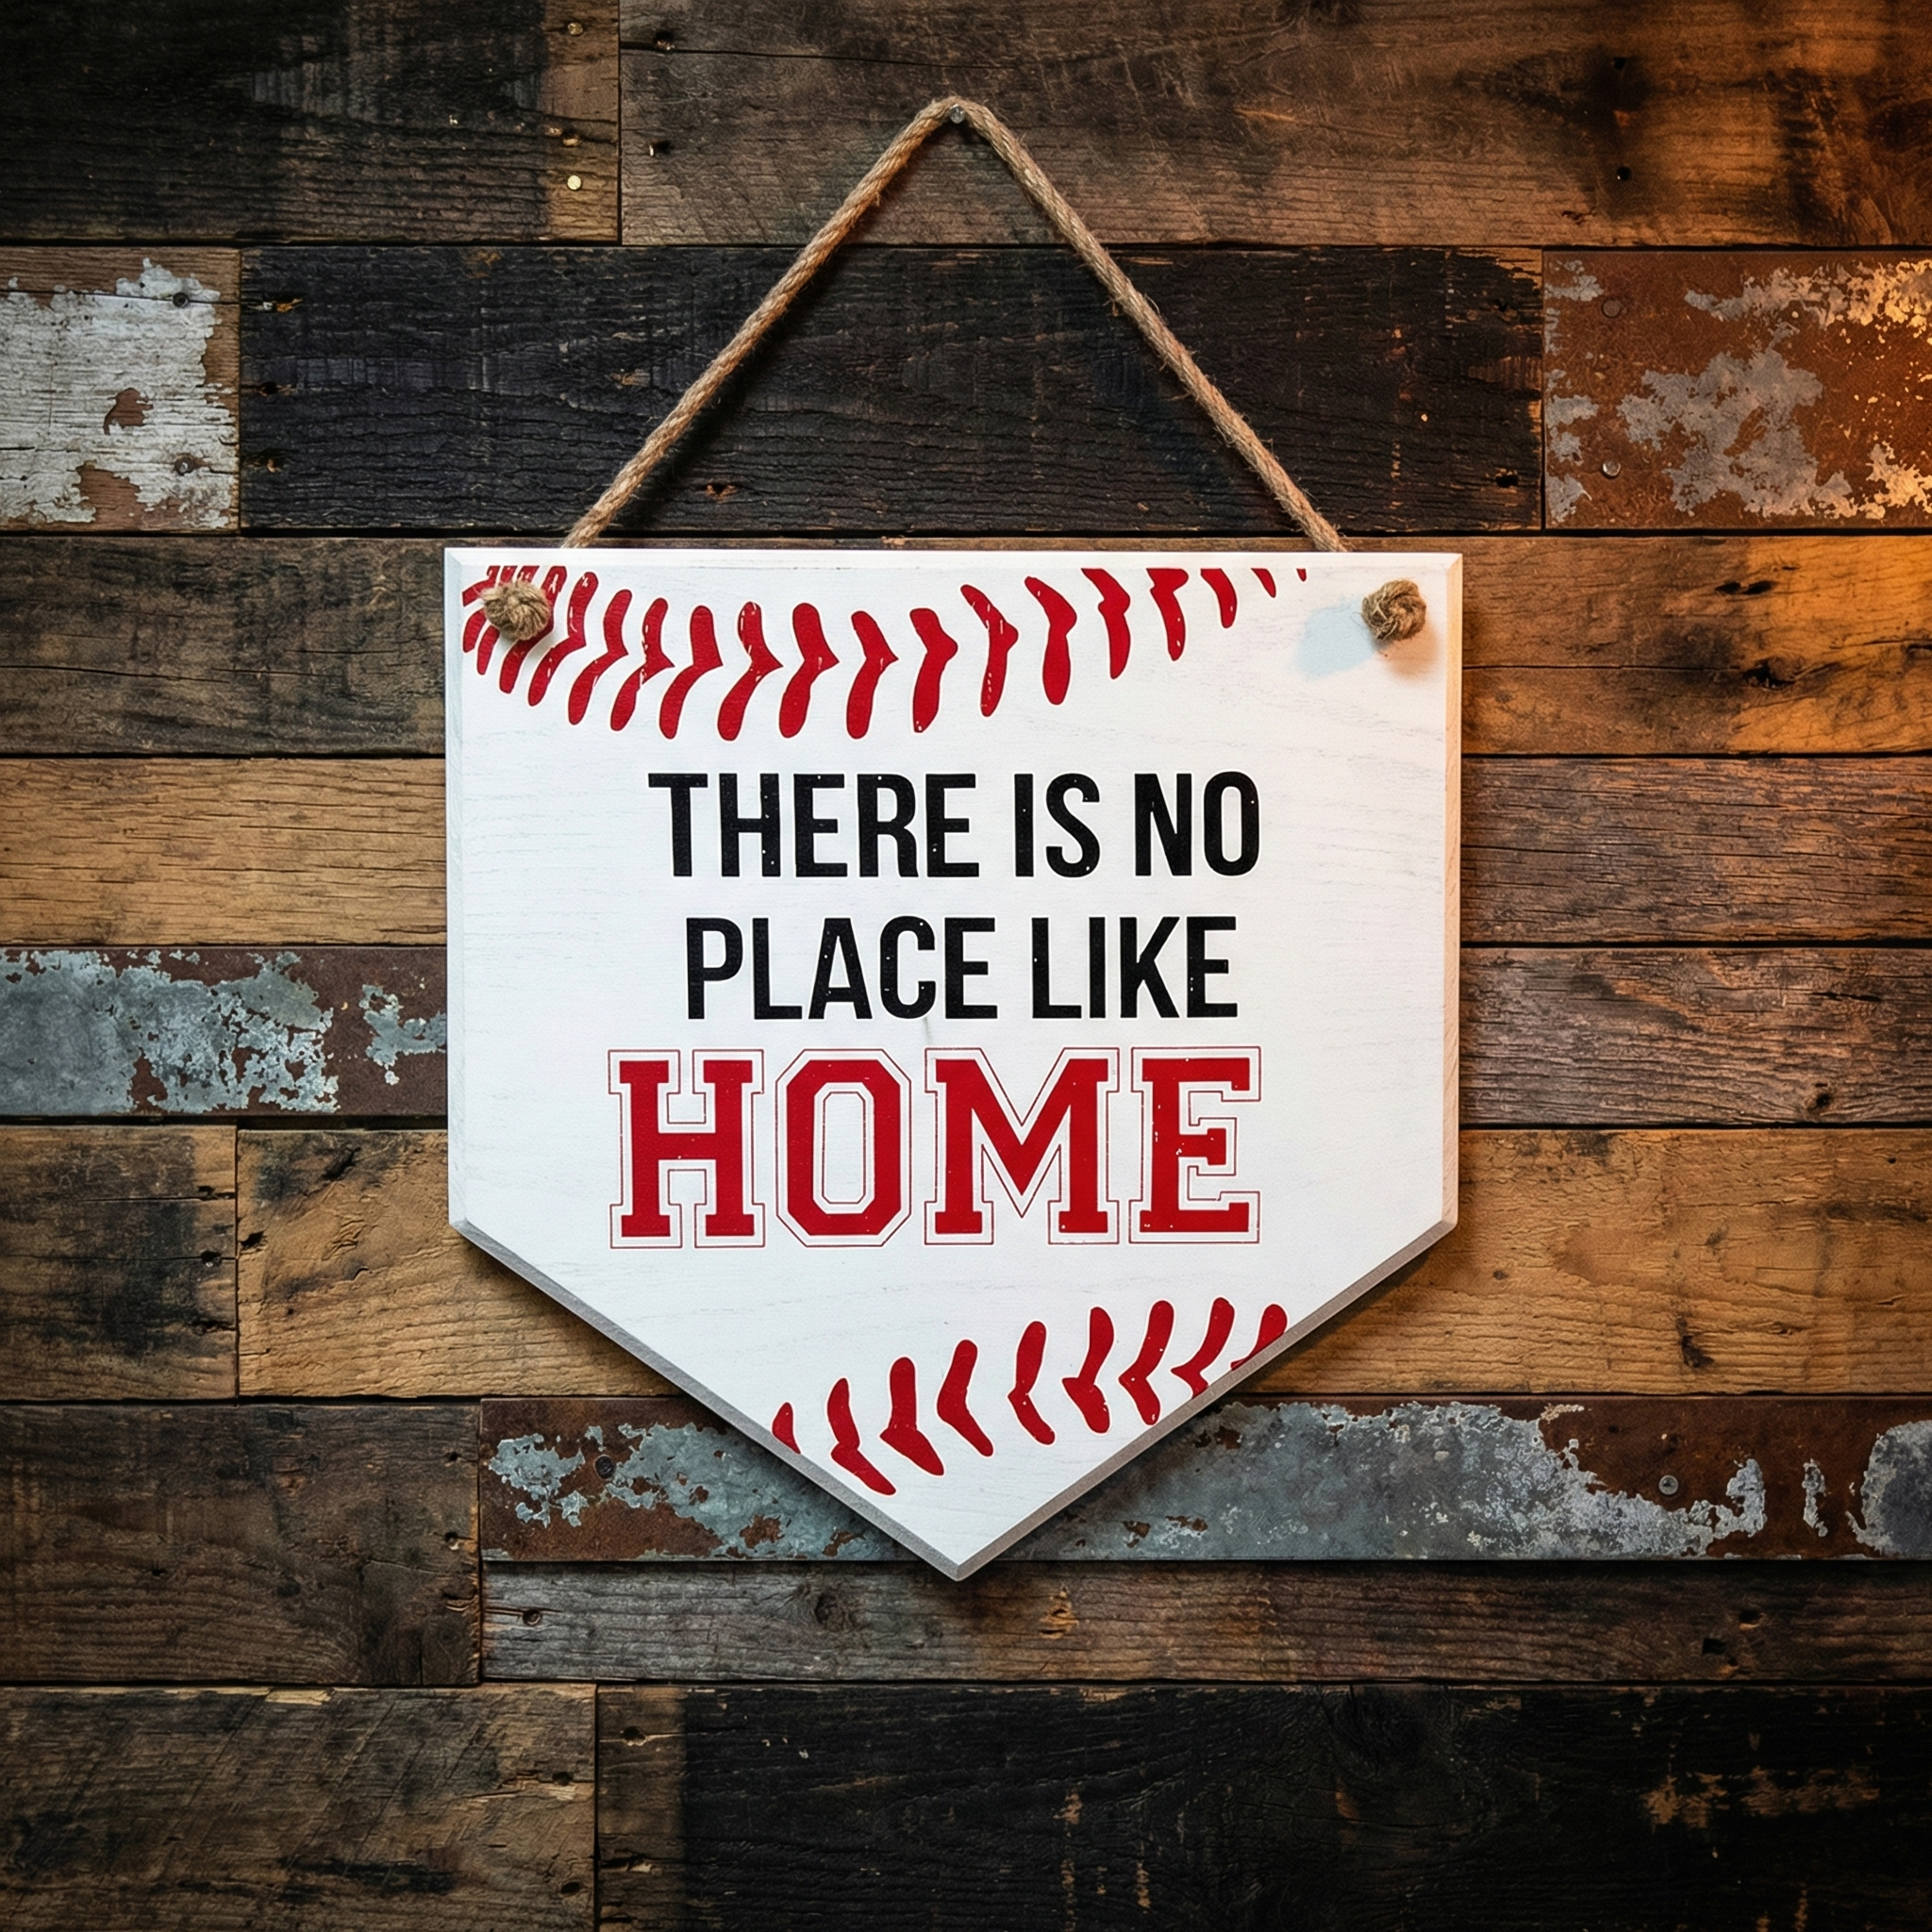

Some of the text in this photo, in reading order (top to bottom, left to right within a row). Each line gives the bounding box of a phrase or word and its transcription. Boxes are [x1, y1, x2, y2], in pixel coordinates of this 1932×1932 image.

[648, 771, 1260, 878] THERE IS NO
[686, 915, 1238, 1020] PLACE LIKE
[608, 1045, 1262, 1249] HOME
